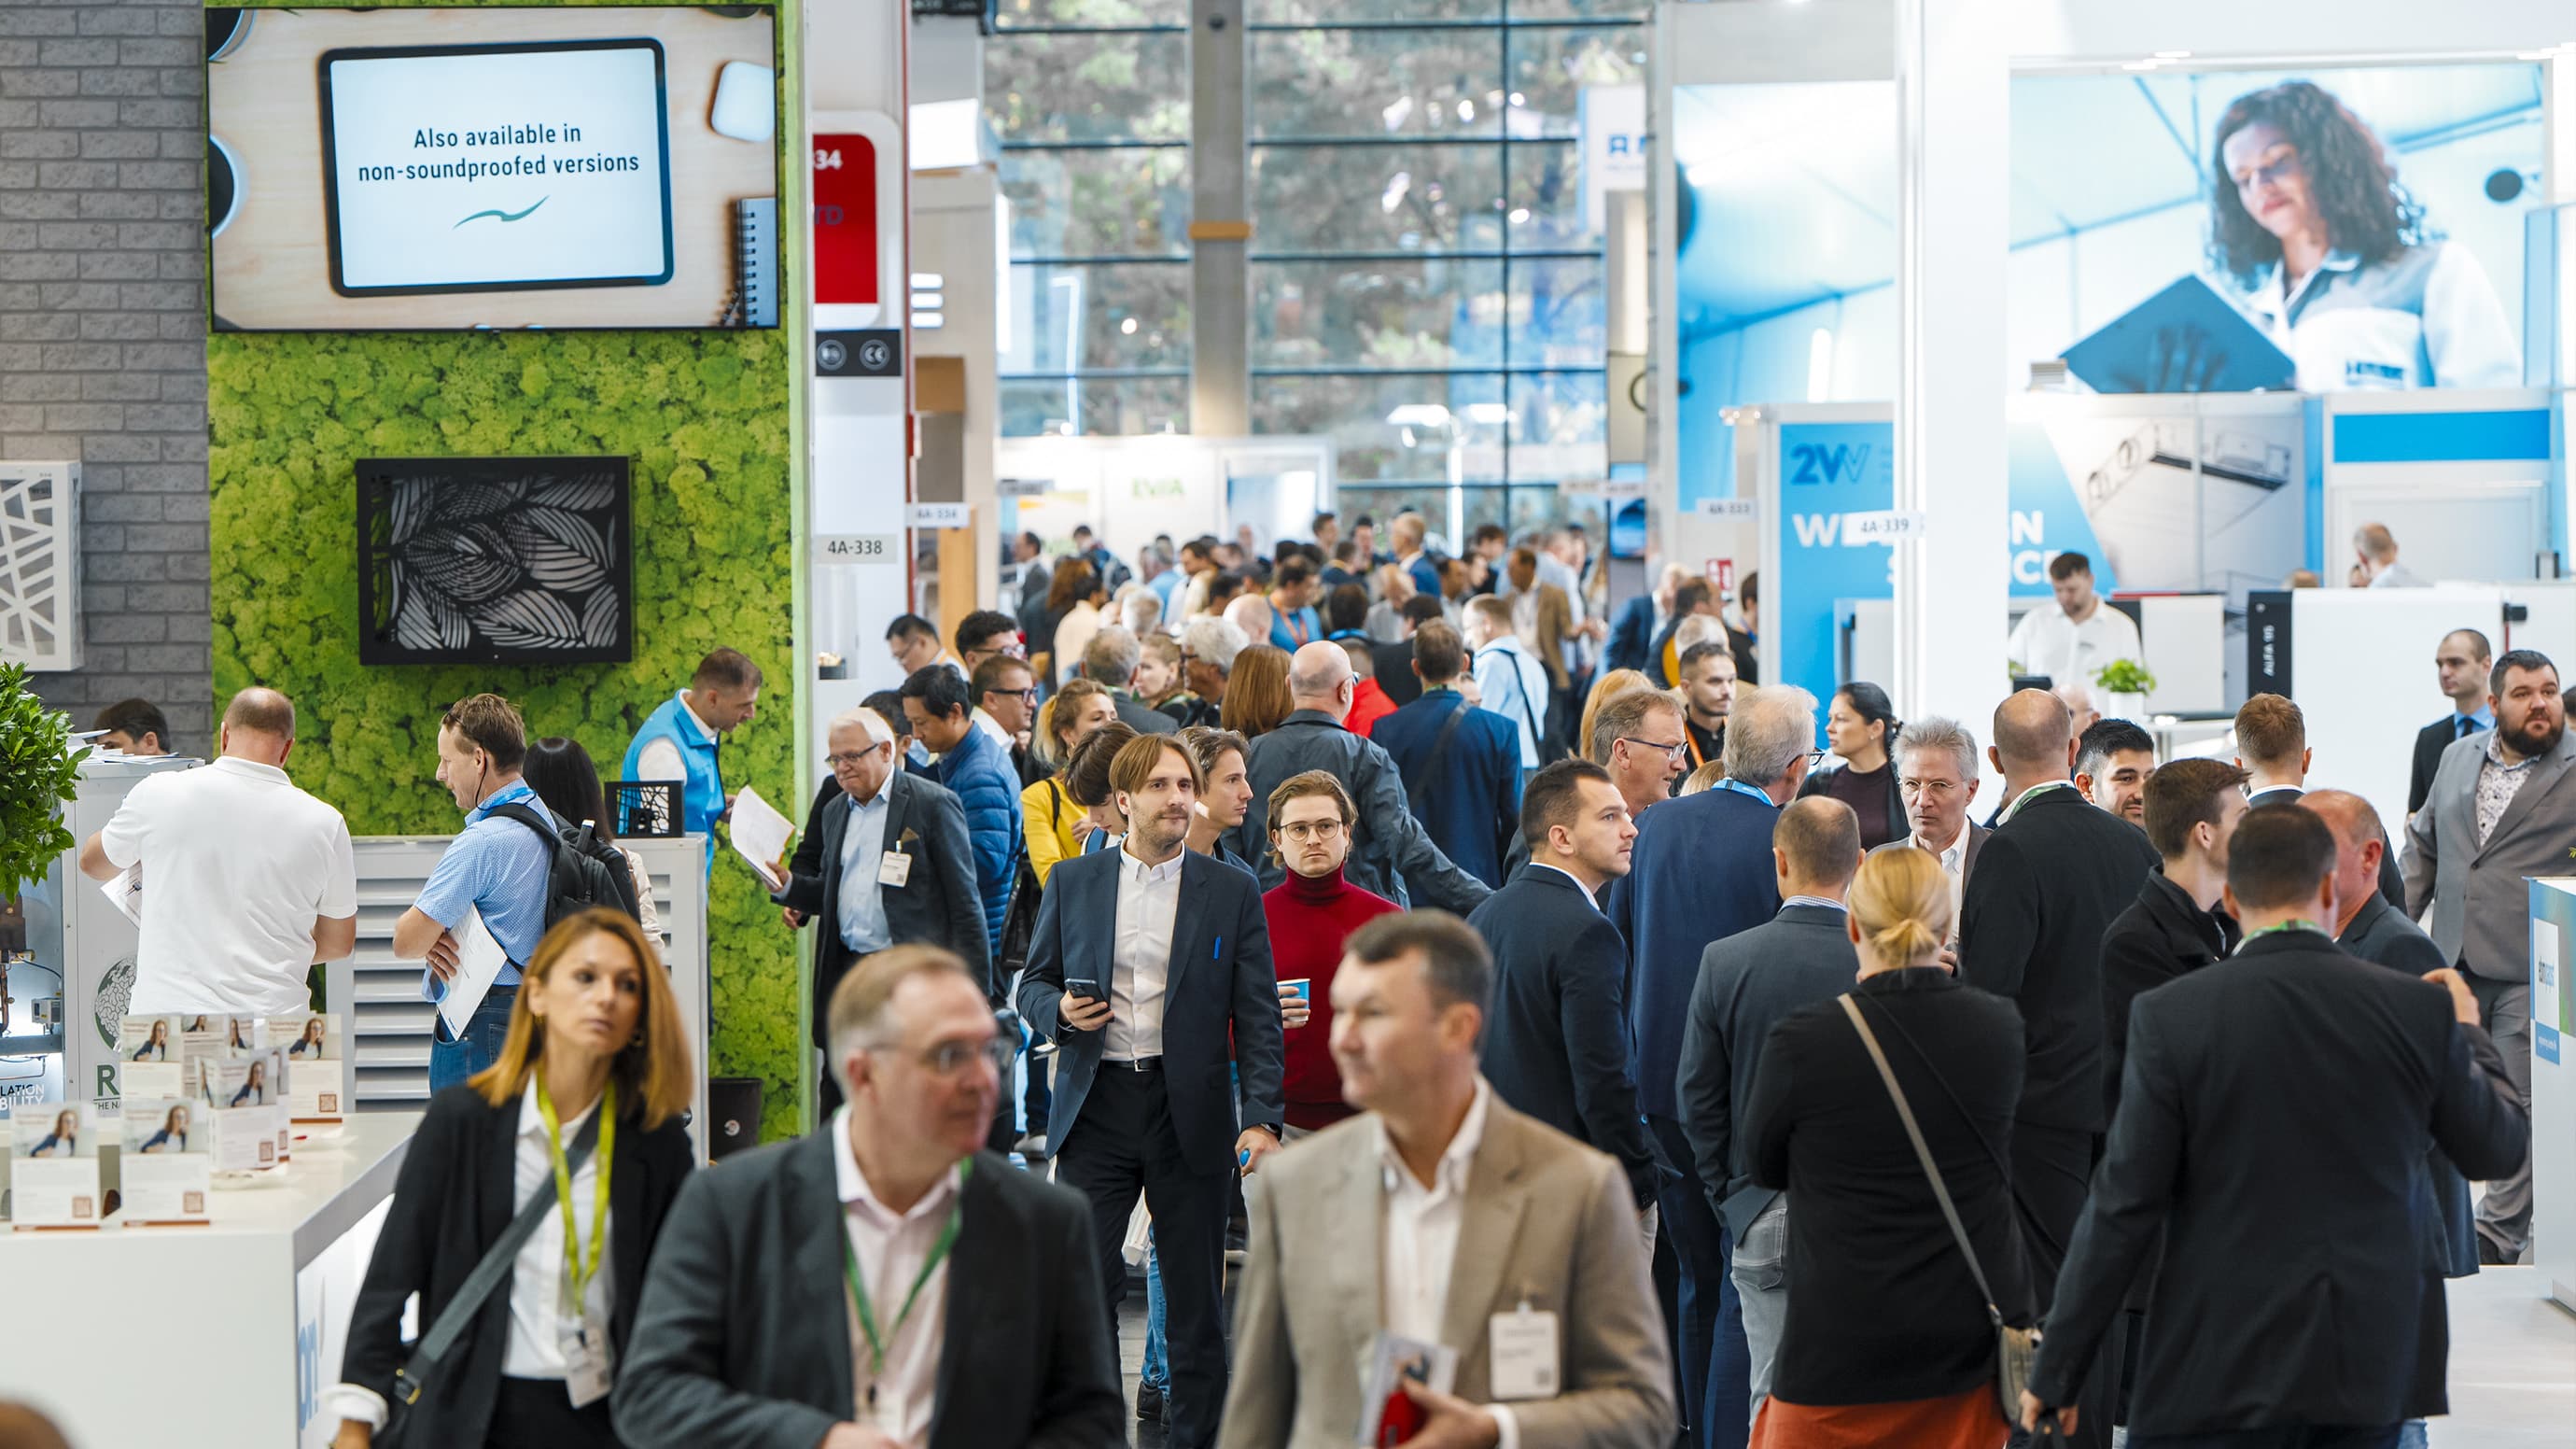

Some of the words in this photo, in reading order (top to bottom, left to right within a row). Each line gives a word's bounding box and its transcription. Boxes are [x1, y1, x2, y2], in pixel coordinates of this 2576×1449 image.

[413, 128, 458, 148] Also
[466, 123, 556, 147] available
[563, 122, 581, 142] in
[358, 154, 547, 182] non-soundproofed
[553, 152, 640, 174] versions
[1860, 517, 1910, 534] 4A-339
[827, 540, 883, 556] 4A-338
